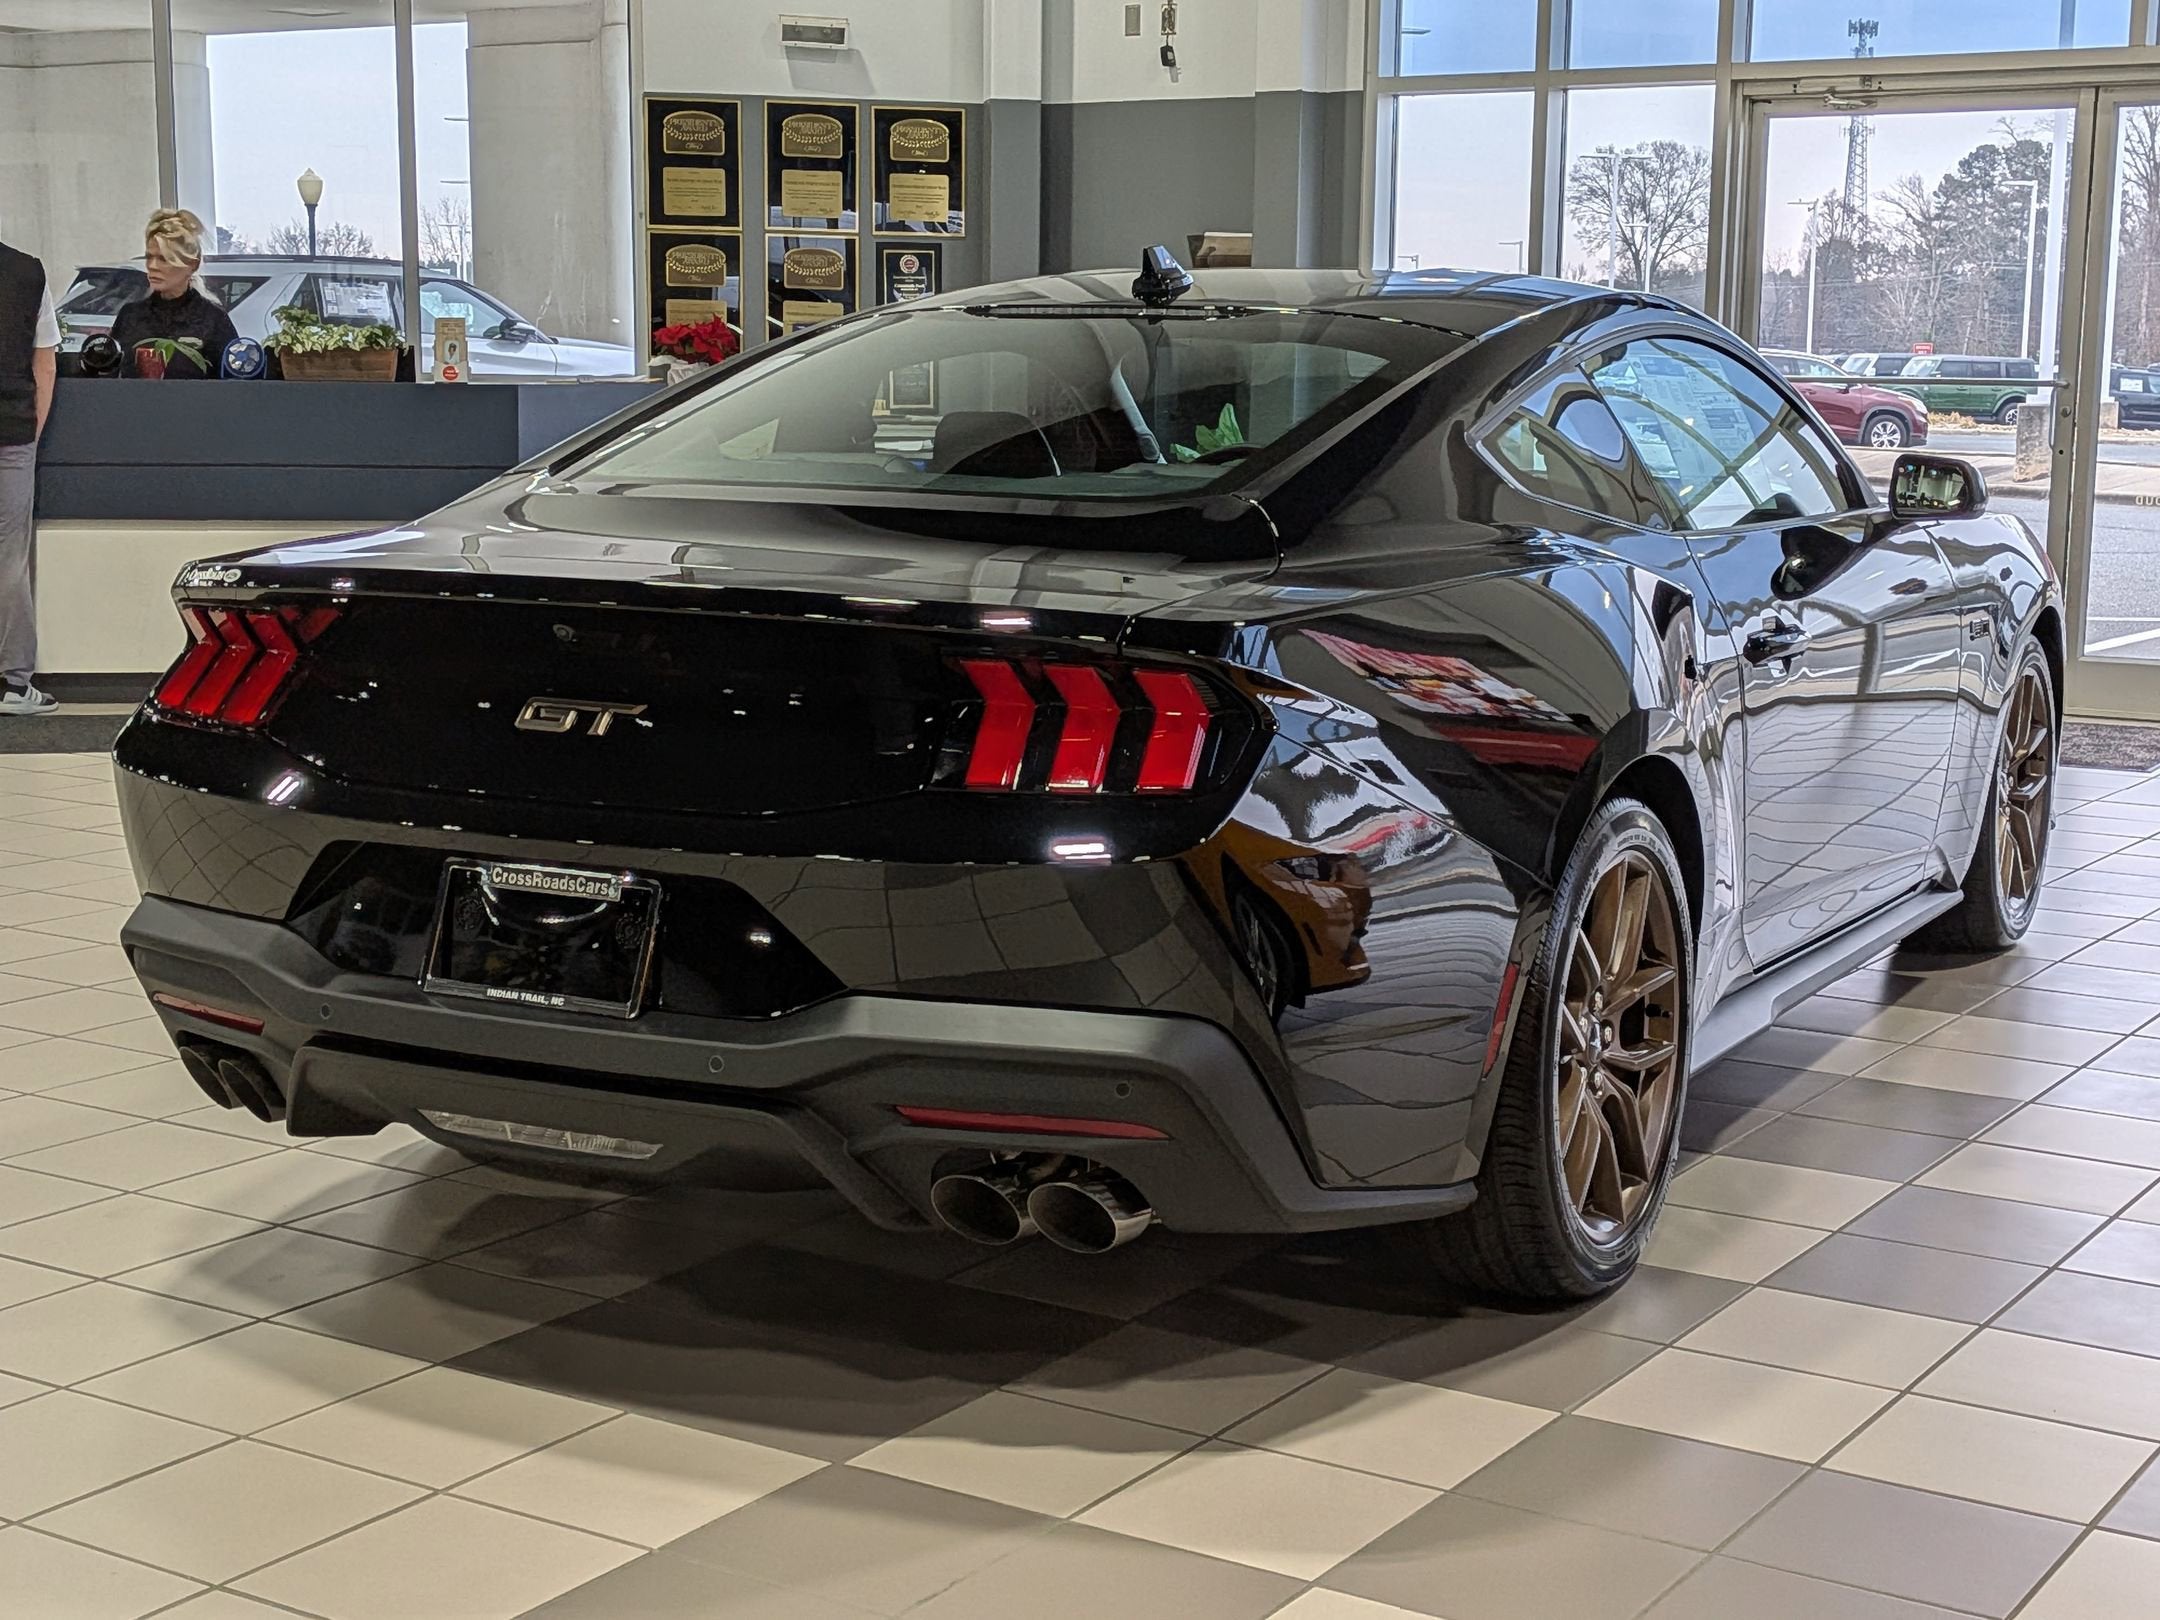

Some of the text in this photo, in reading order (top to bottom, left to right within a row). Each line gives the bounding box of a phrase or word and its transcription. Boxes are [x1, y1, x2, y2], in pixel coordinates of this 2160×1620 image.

[514, 696, 648, 736] GT
[492, 866, 609, 895] CrossRoadsCars
[486, 987, 519, 1000] INDIAN
[550, 996, 566, 1006] NC
